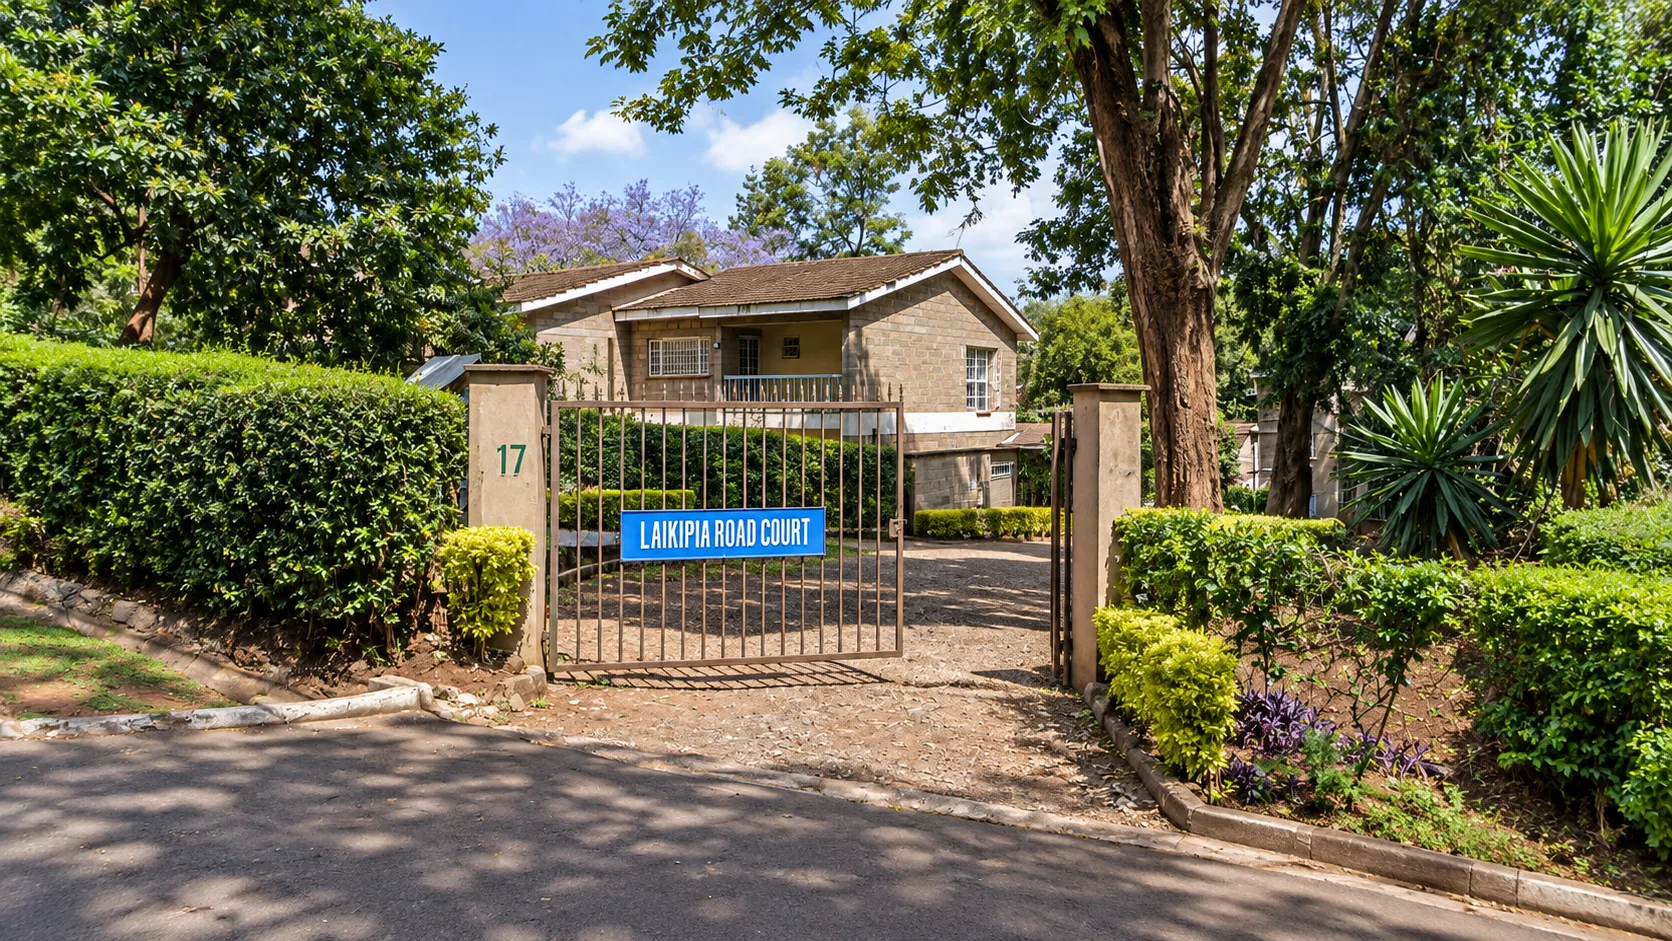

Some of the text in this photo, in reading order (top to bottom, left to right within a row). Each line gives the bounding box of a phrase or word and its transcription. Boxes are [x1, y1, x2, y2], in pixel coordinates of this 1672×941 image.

[497, 444, 527, 475] 17
[640, 517, 811, 550] LAIKIPIA ROAD COURT
